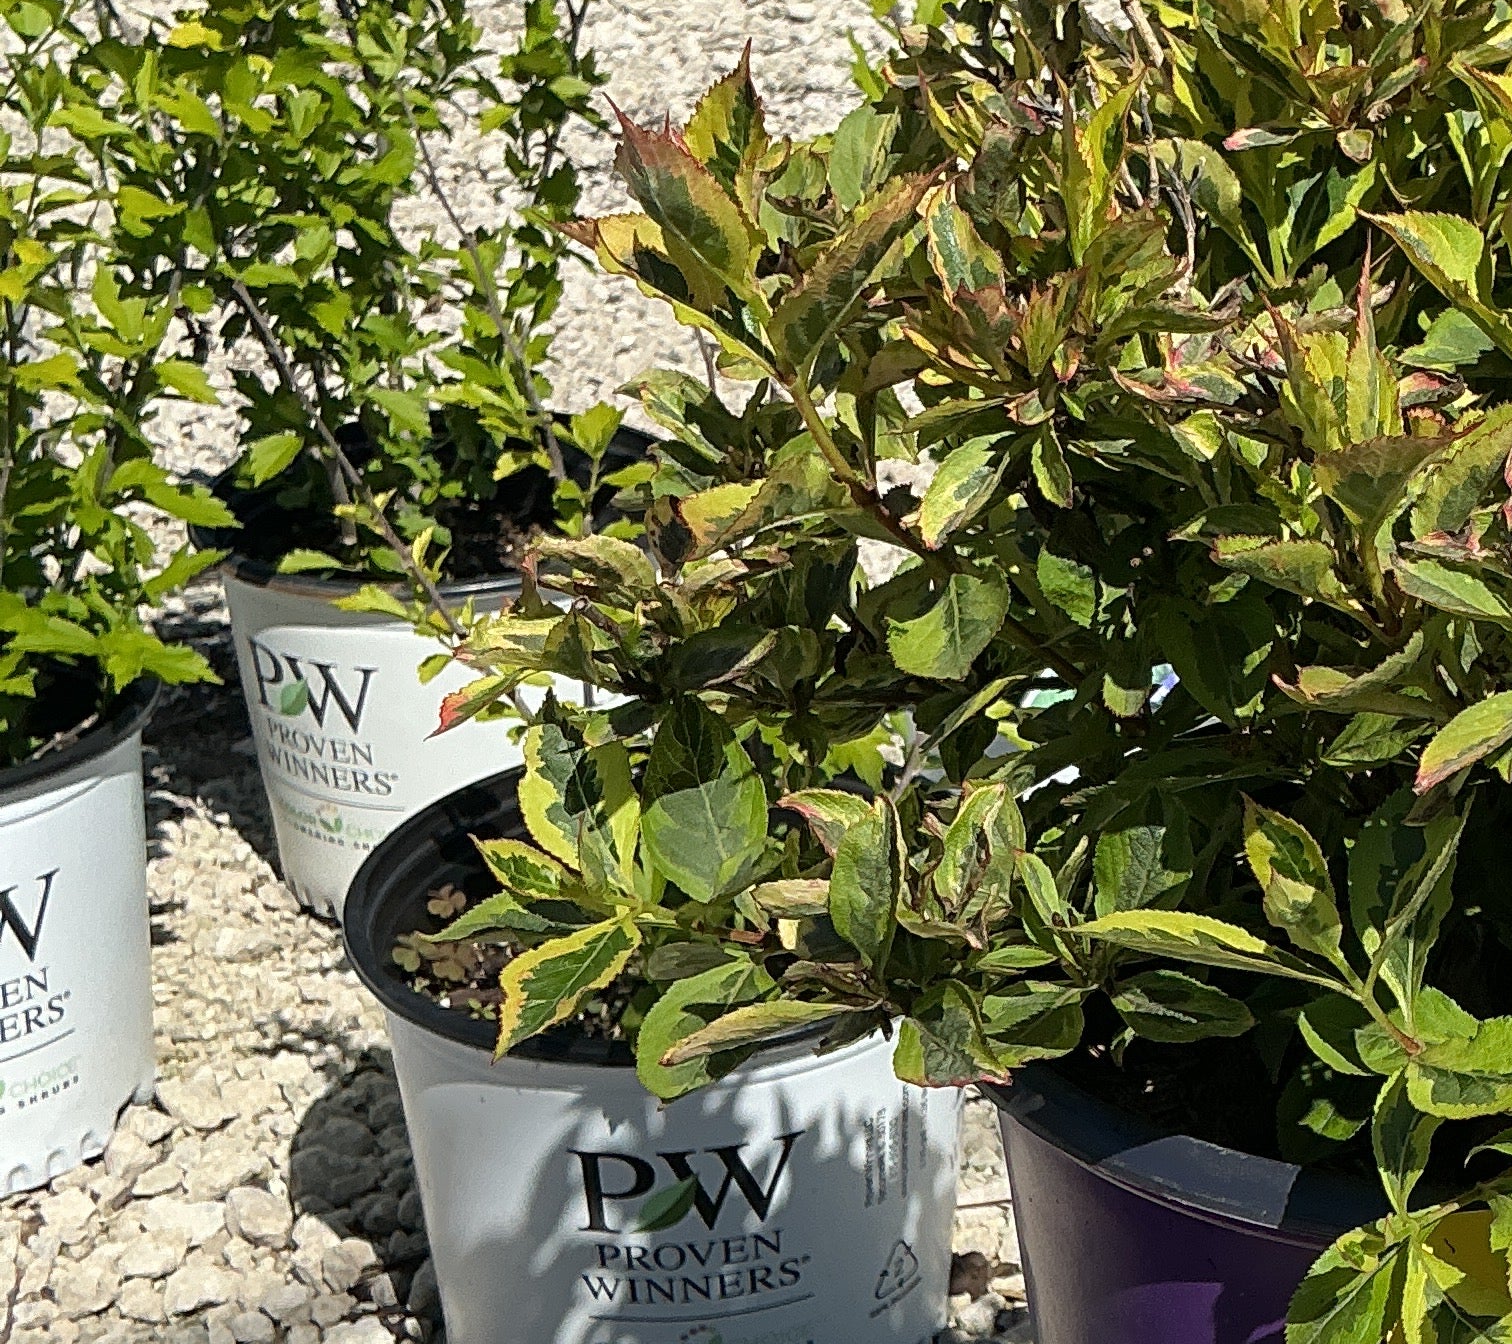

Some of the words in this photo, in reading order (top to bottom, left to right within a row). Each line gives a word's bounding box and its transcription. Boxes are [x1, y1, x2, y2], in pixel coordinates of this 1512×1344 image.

[248, 638, 378, 735] PW
[266, 716, 374, 767] PROVEN
[566, 1130, 806, 1233] PW
[595, 1229, 785, 1273] PROVEN
